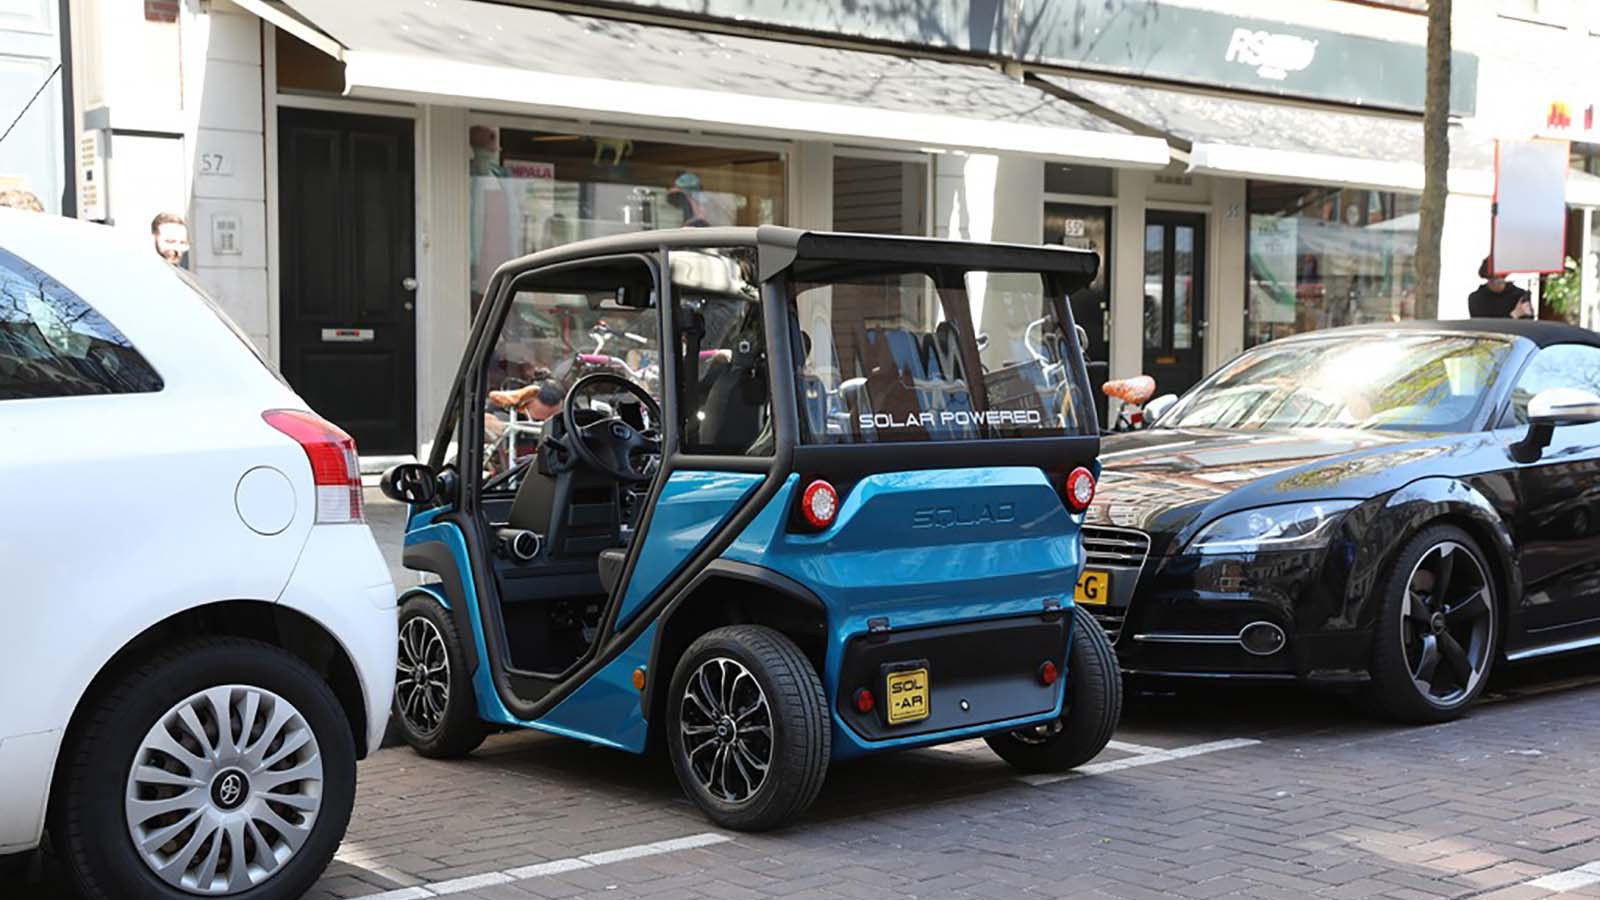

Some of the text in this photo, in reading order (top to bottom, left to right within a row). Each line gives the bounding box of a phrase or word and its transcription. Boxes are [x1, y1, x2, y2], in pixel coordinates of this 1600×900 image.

[202, 153, 223, 171] 57
[859, 410, 1041, 428] SOLAR POWERED
[912, 502, 1015, 528] SQUAD
[892, 680, 923, 694] SOL
[895, 695, 923, 709] -AR
